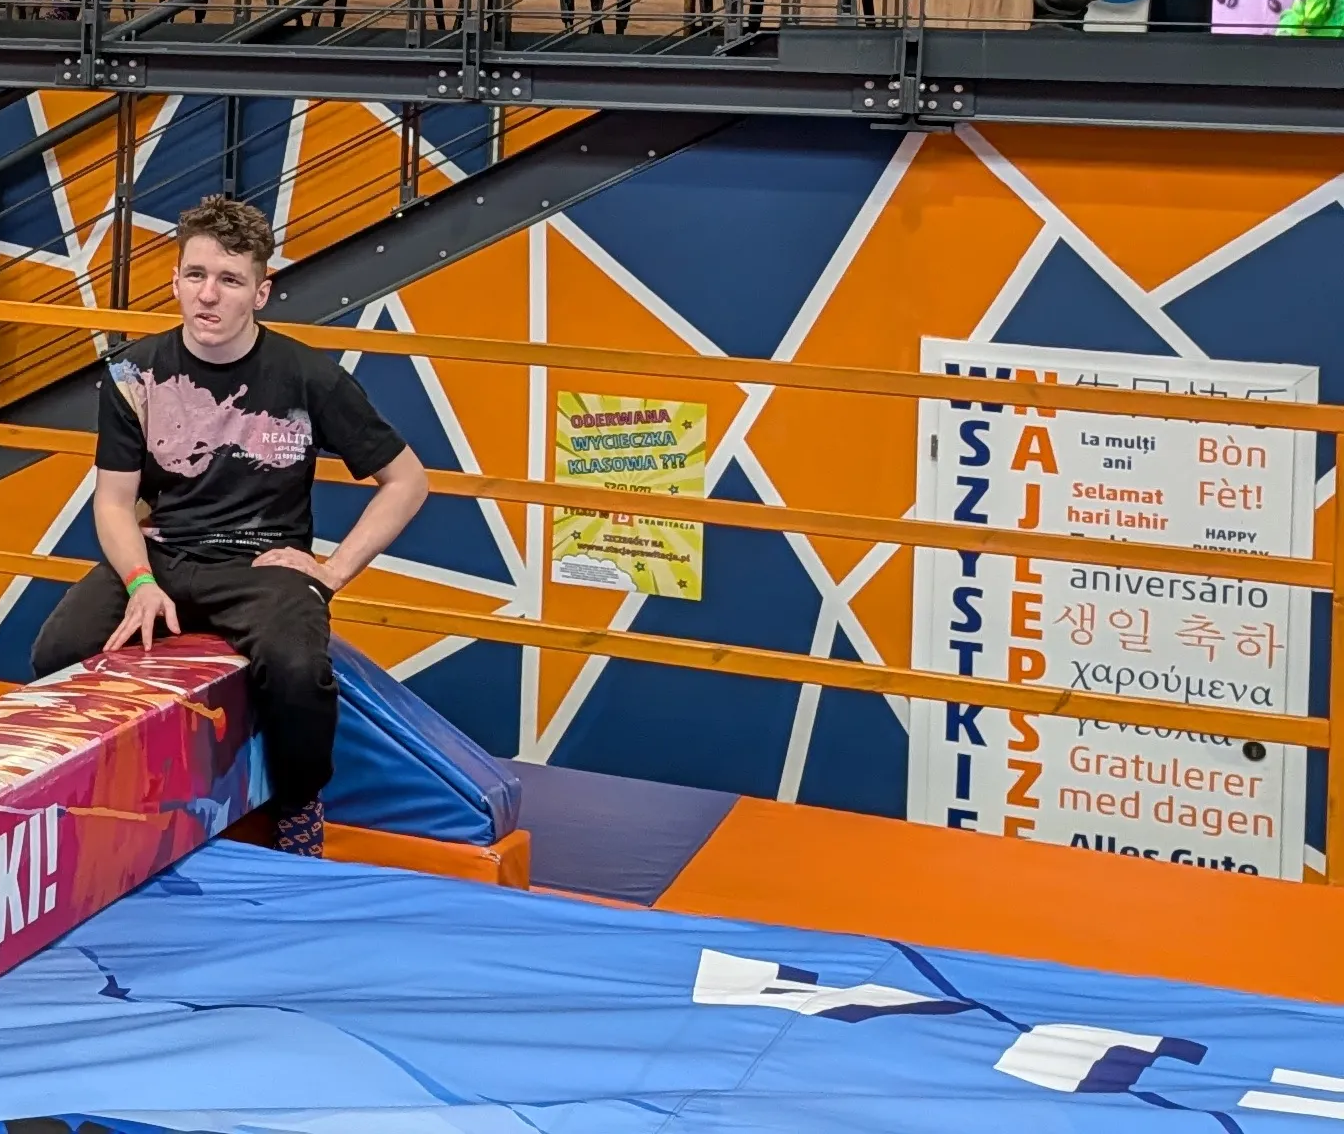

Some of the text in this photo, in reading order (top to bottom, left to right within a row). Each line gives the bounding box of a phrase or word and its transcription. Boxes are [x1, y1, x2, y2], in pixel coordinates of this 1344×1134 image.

[262, 432, 313, 445] REALITY
[571, 431, 677, 451] WYCIECZKA
[1080, 431, 1156, 455] La mulți
[1102, 455, 1132, 470] ani
[1198, 435, 1267, 469] Bòn
[568, 455, 658, 475] KLASOWA
[1072, 482, 1164, 506] Selamat
[1199, 478, 1262, 510] Fèt!
[638, 518, 695, 530] GRAWITACJA
[1067, 505, 1169, 530] hari lahir
[1205, 527, 1257, 544] HAPPY
[1070, 567, 1268, 609] aniversário
[1052, 602, 1285, 669] 생일 축하
[1071, 660, 1274, 707] χαρούμενα
[1070, 746, 1263, 799] Gratulerer
[1059, 786, 1274, 838] med dagen
